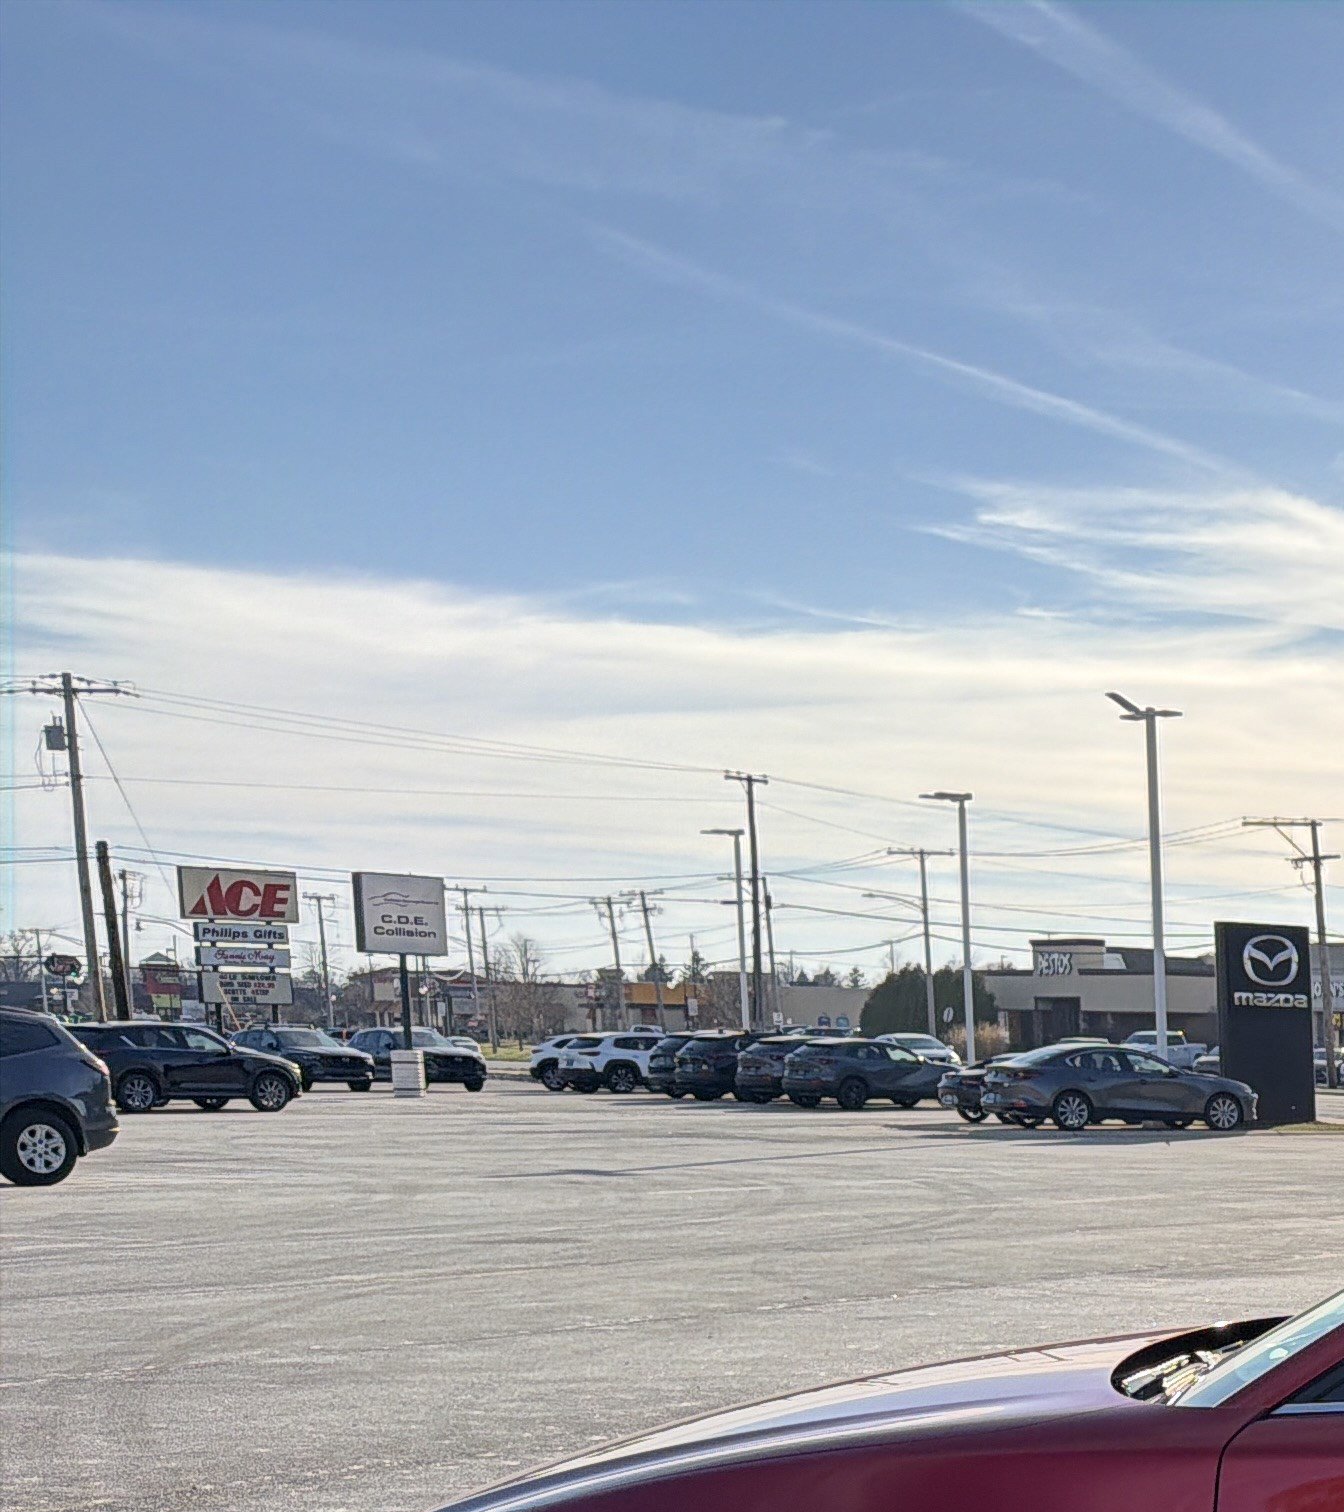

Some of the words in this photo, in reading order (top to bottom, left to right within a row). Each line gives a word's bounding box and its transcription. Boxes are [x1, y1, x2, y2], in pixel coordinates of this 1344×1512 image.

[189, 873, 291, 917] ACE
[381, 914, 428, 926] C.D.E.
[253, 928, 285, 940] Gifts
[373, 926, 437, 939] Collision
[1233, 991, 1309, 1009] mazda
